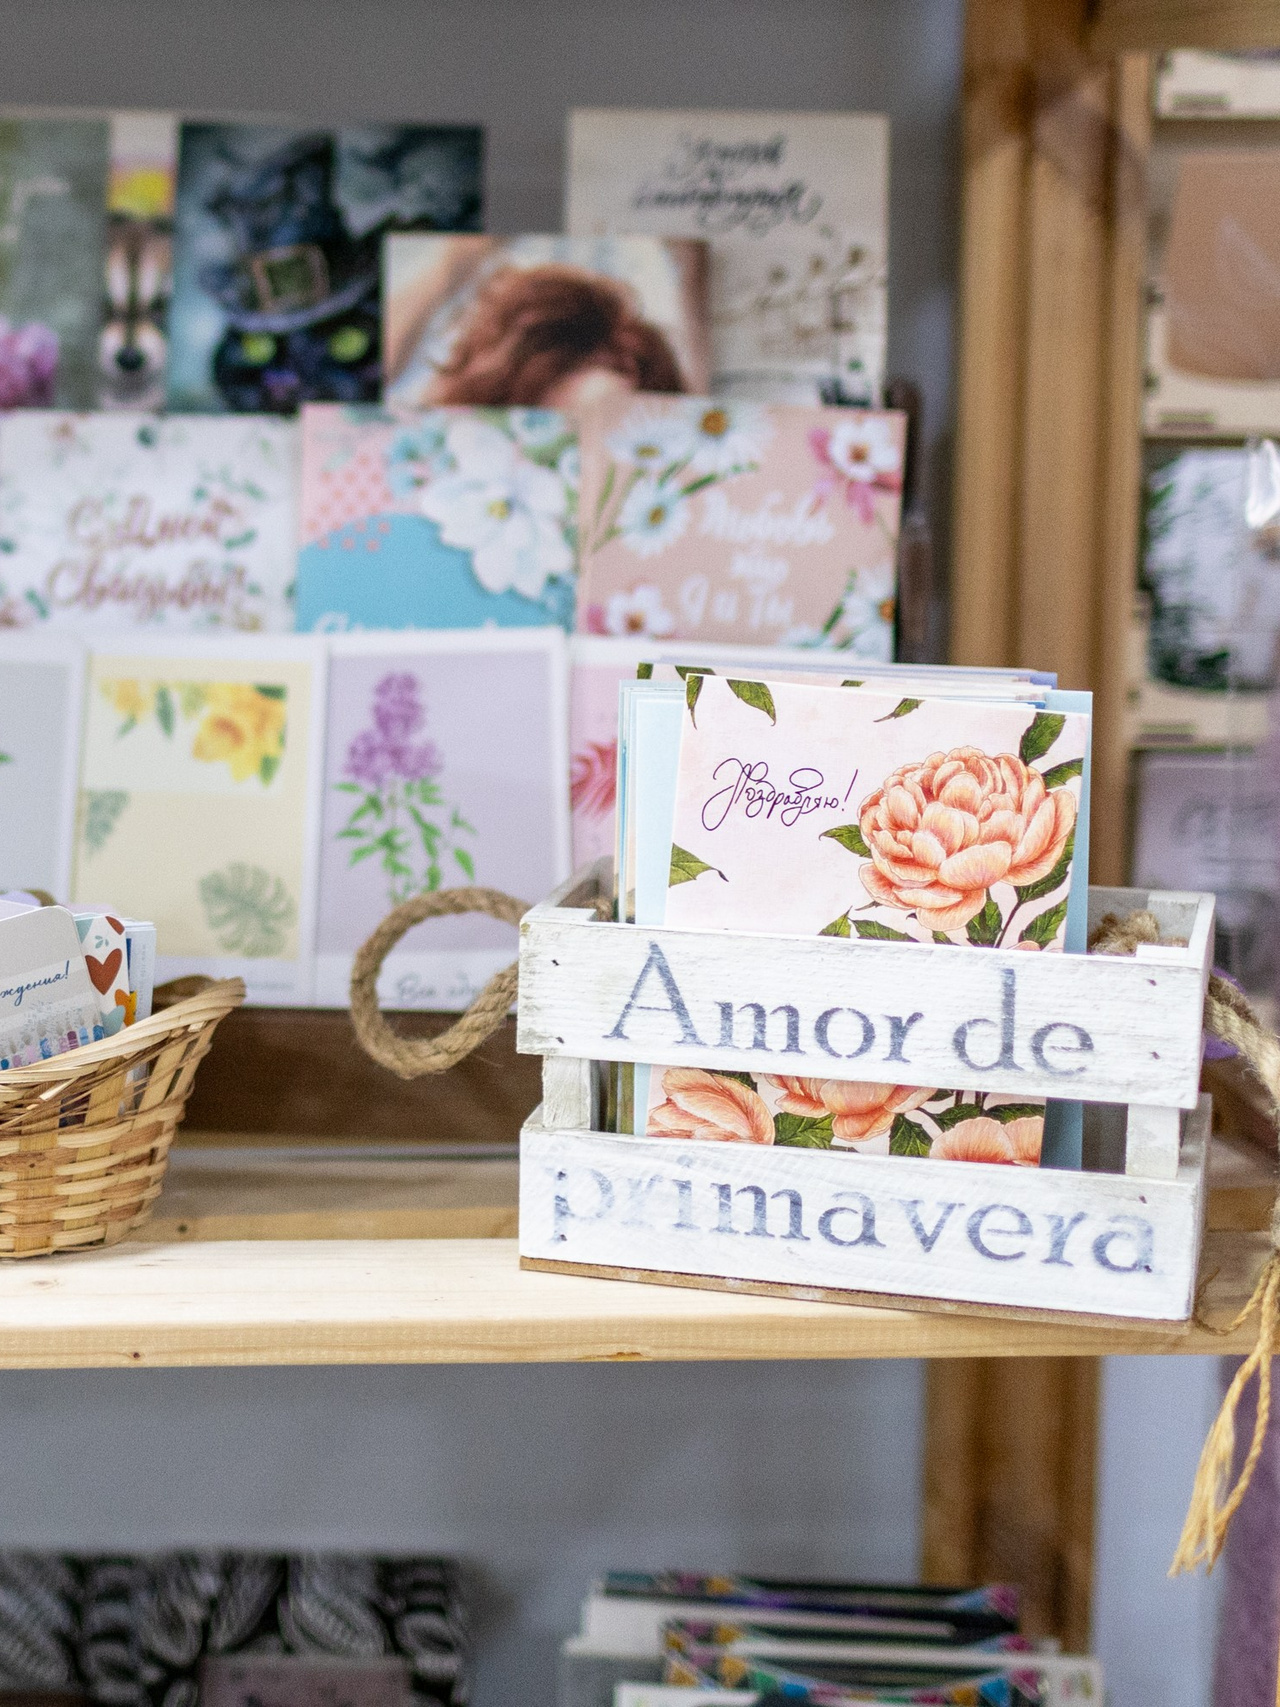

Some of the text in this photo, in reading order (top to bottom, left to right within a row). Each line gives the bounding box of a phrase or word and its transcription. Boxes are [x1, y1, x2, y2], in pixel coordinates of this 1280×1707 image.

[702, 757, 858, 831] Поздравляю!
[602, 940, 1095, 1076] Amor de
[544, 1154, 1161, 1275] primavera
